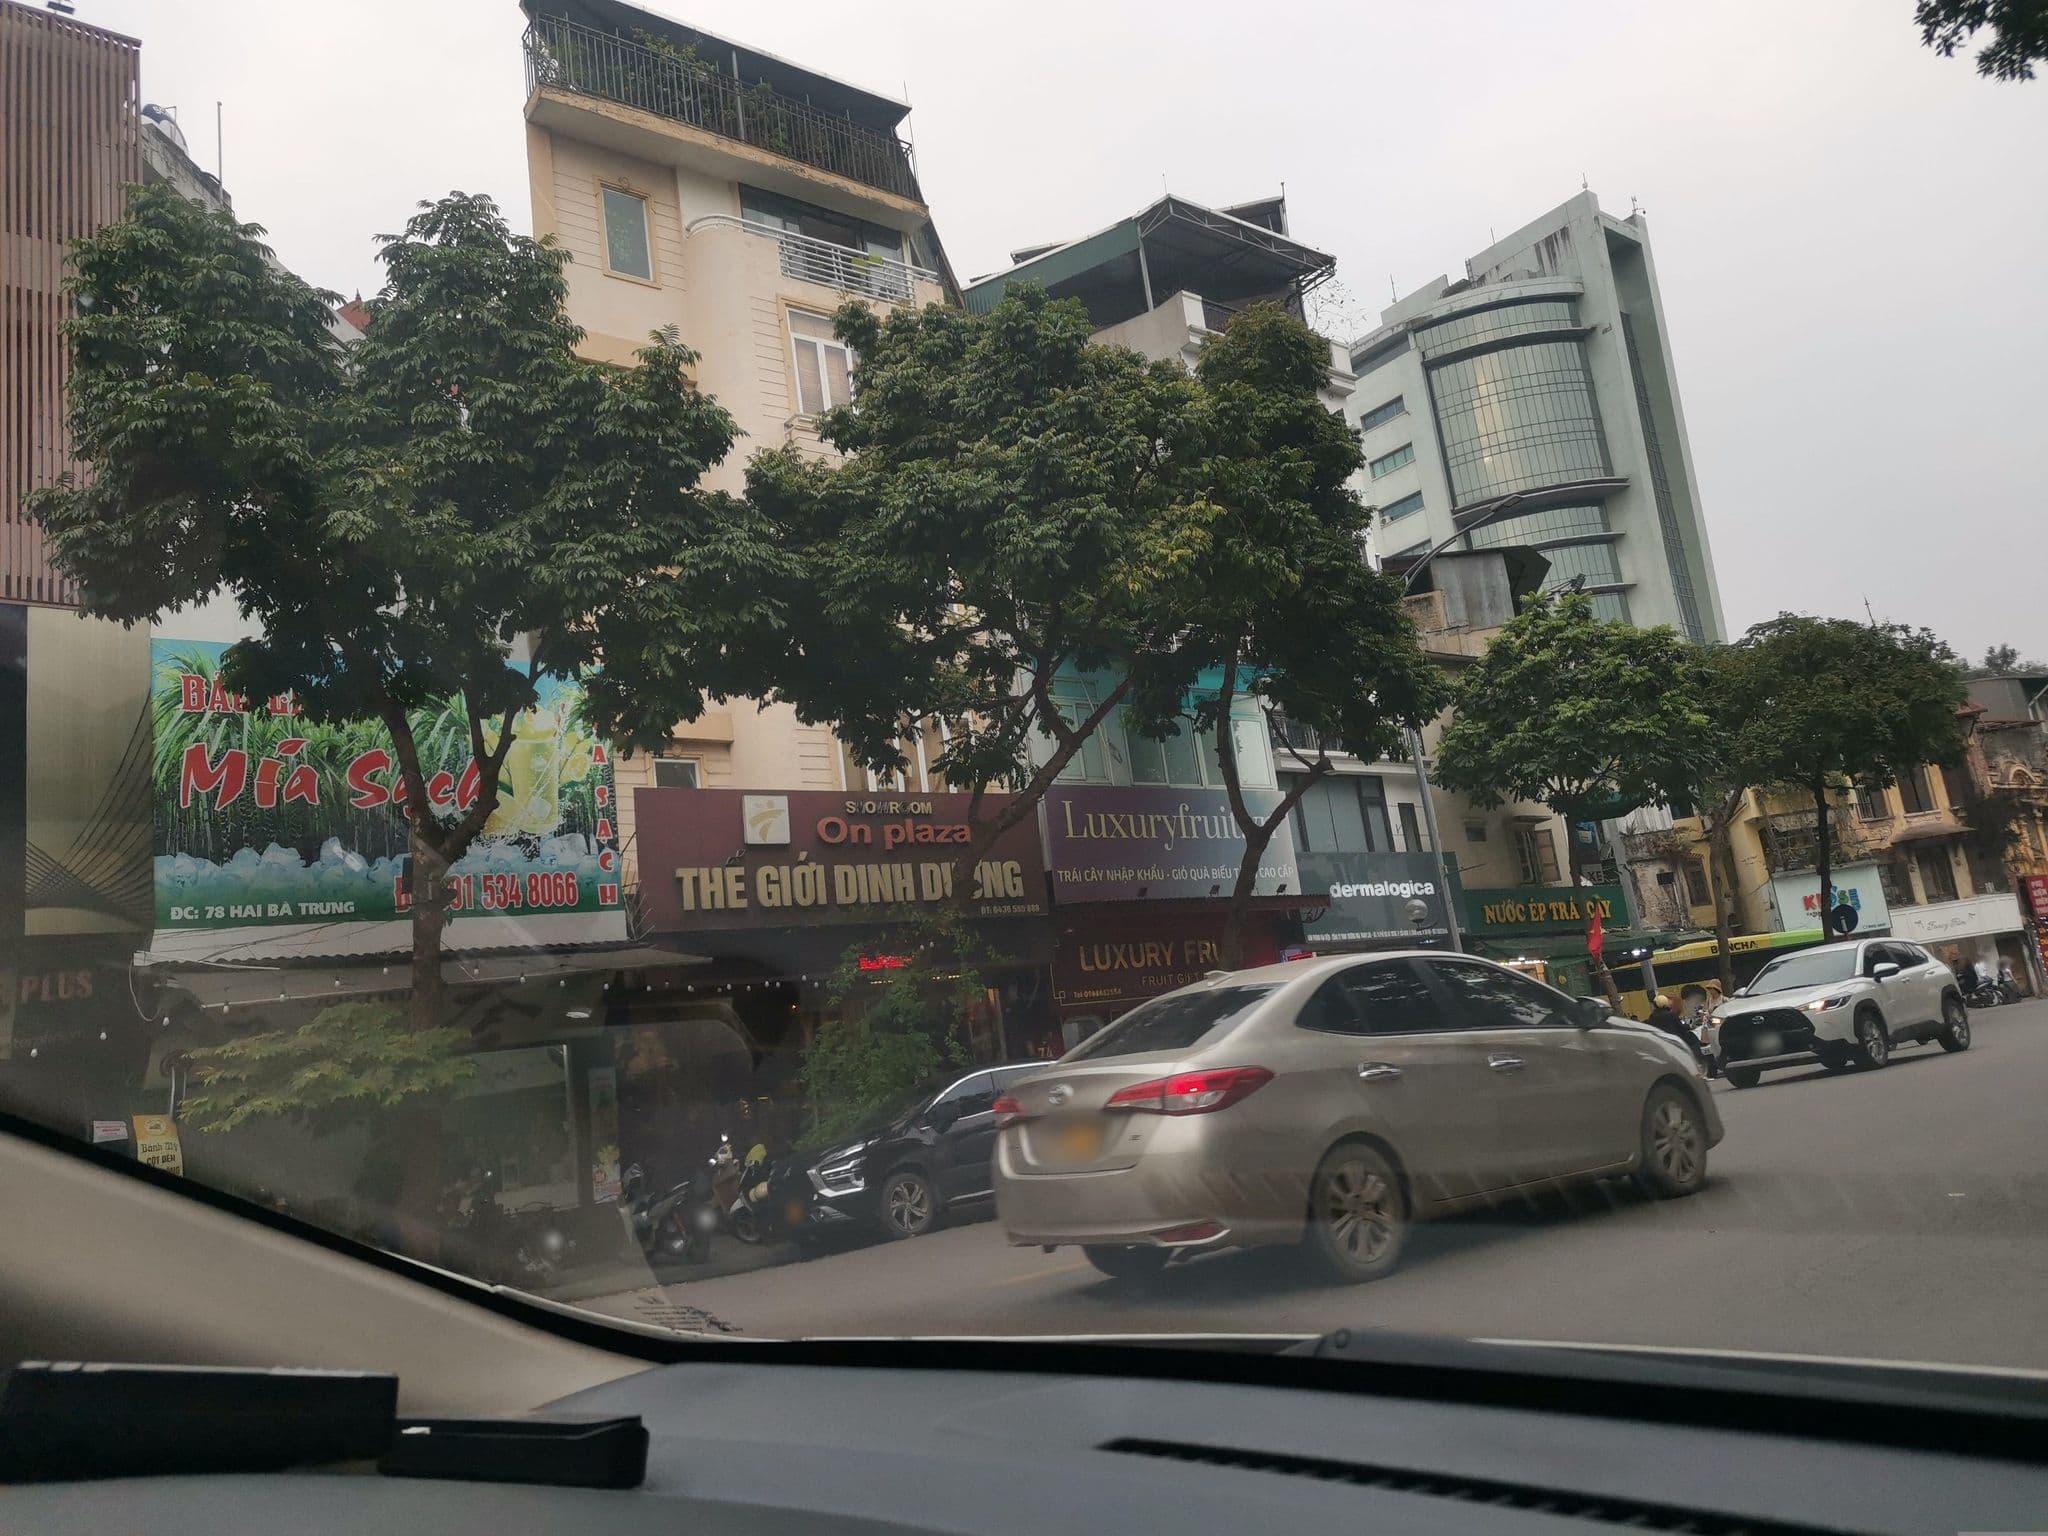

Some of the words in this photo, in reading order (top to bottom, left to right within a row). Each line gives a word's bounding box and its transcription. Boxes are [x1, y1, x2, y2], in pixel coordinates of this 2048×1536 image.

[817, 816, 873, 845] On
[883, 818, 972, 850] plaza
[756, 851, 827, 907] GIỚI
[834, 862, 915, 905] DINH
[1057, 865, 1082, 882] TRÁI
[1085, 866, 1103, 882] CÂY
[1107, 866, 1134, 884] NHẬP
[1138, 864, 1164, 880] KHẨU
[1190, 864, 1210, 880] QUÀ
[1212, 864, 1232, 880] BIẾU
[1259, 867, 1276, 878] CAO
[1278, 863, 1294, 878] CẤP
[482, 873, 521, 910] 534
[526, 871, 578, 907] 8066
[1329, 880, 1436, 898] dermalogica
[170, 906, 199, 920] ĐC:
[205, 904, 225, 919] 78
[230, 903, 263, 918] HAI
[267, 900, 293, 917] BÀ
[1484, 899, 1526, 924] NƯỚC
[1529, 897, 1547, 922] ÉP
[1079, 941, 1174, 972] LUXURY
[1710, 940, 1757, 955] BNCHA
[1141, 973, 1174, 987] FRUIT
